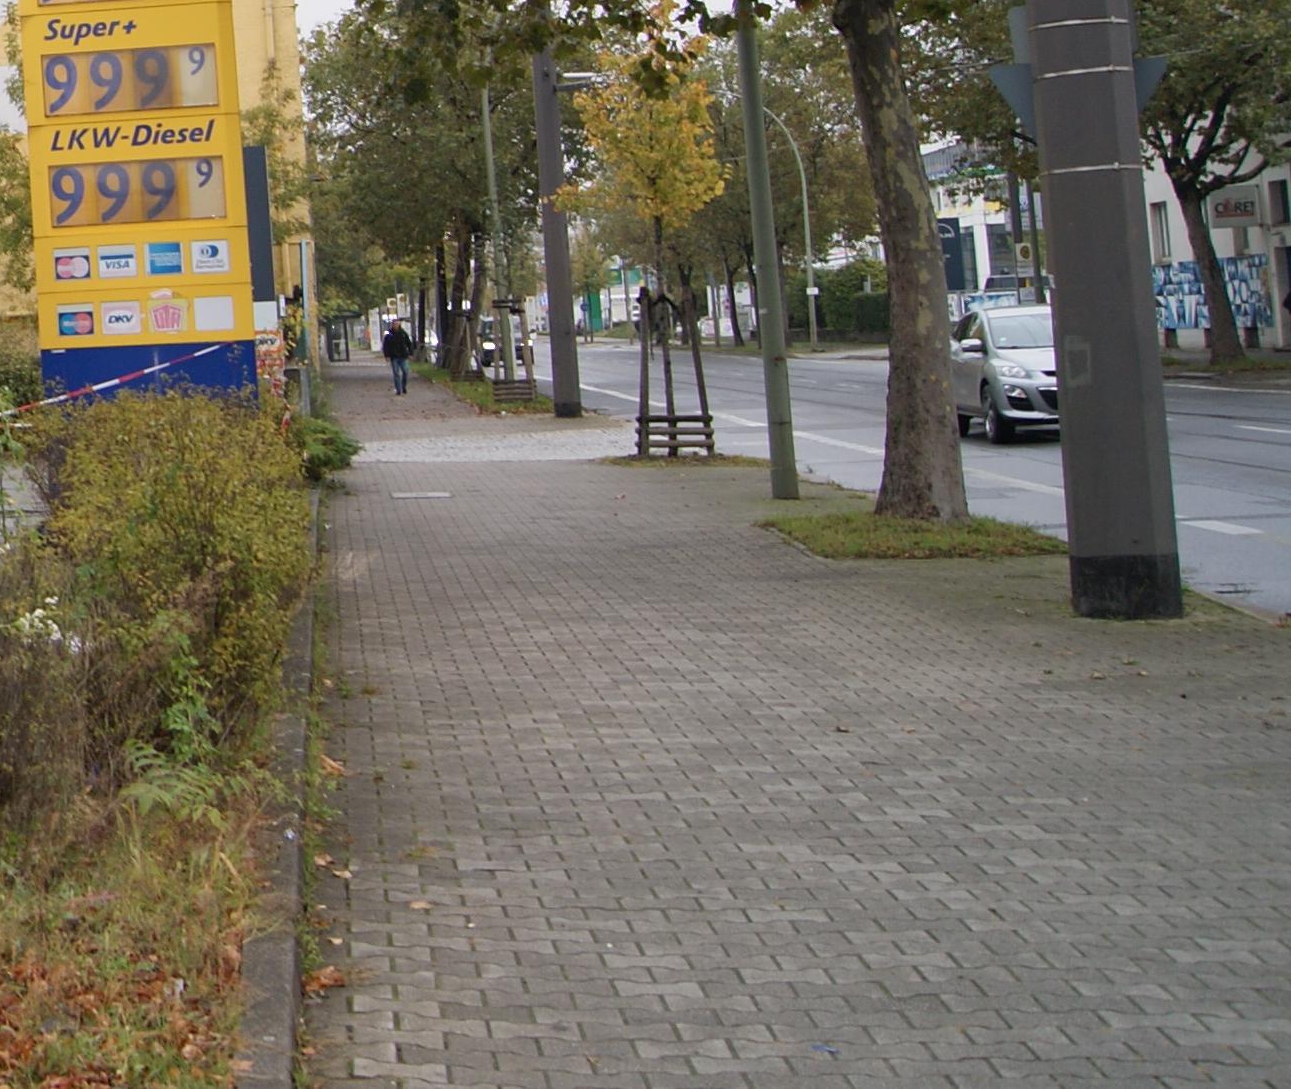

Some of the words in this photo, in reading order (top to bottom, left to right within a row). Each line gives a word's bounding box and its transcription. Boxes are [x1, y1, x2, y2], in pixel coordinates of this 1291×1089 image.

[50, 119, 215, 152] LKW-Diesel
[104, 260, 130, 270] VISA
[108, 314, 133, 324] DKV
